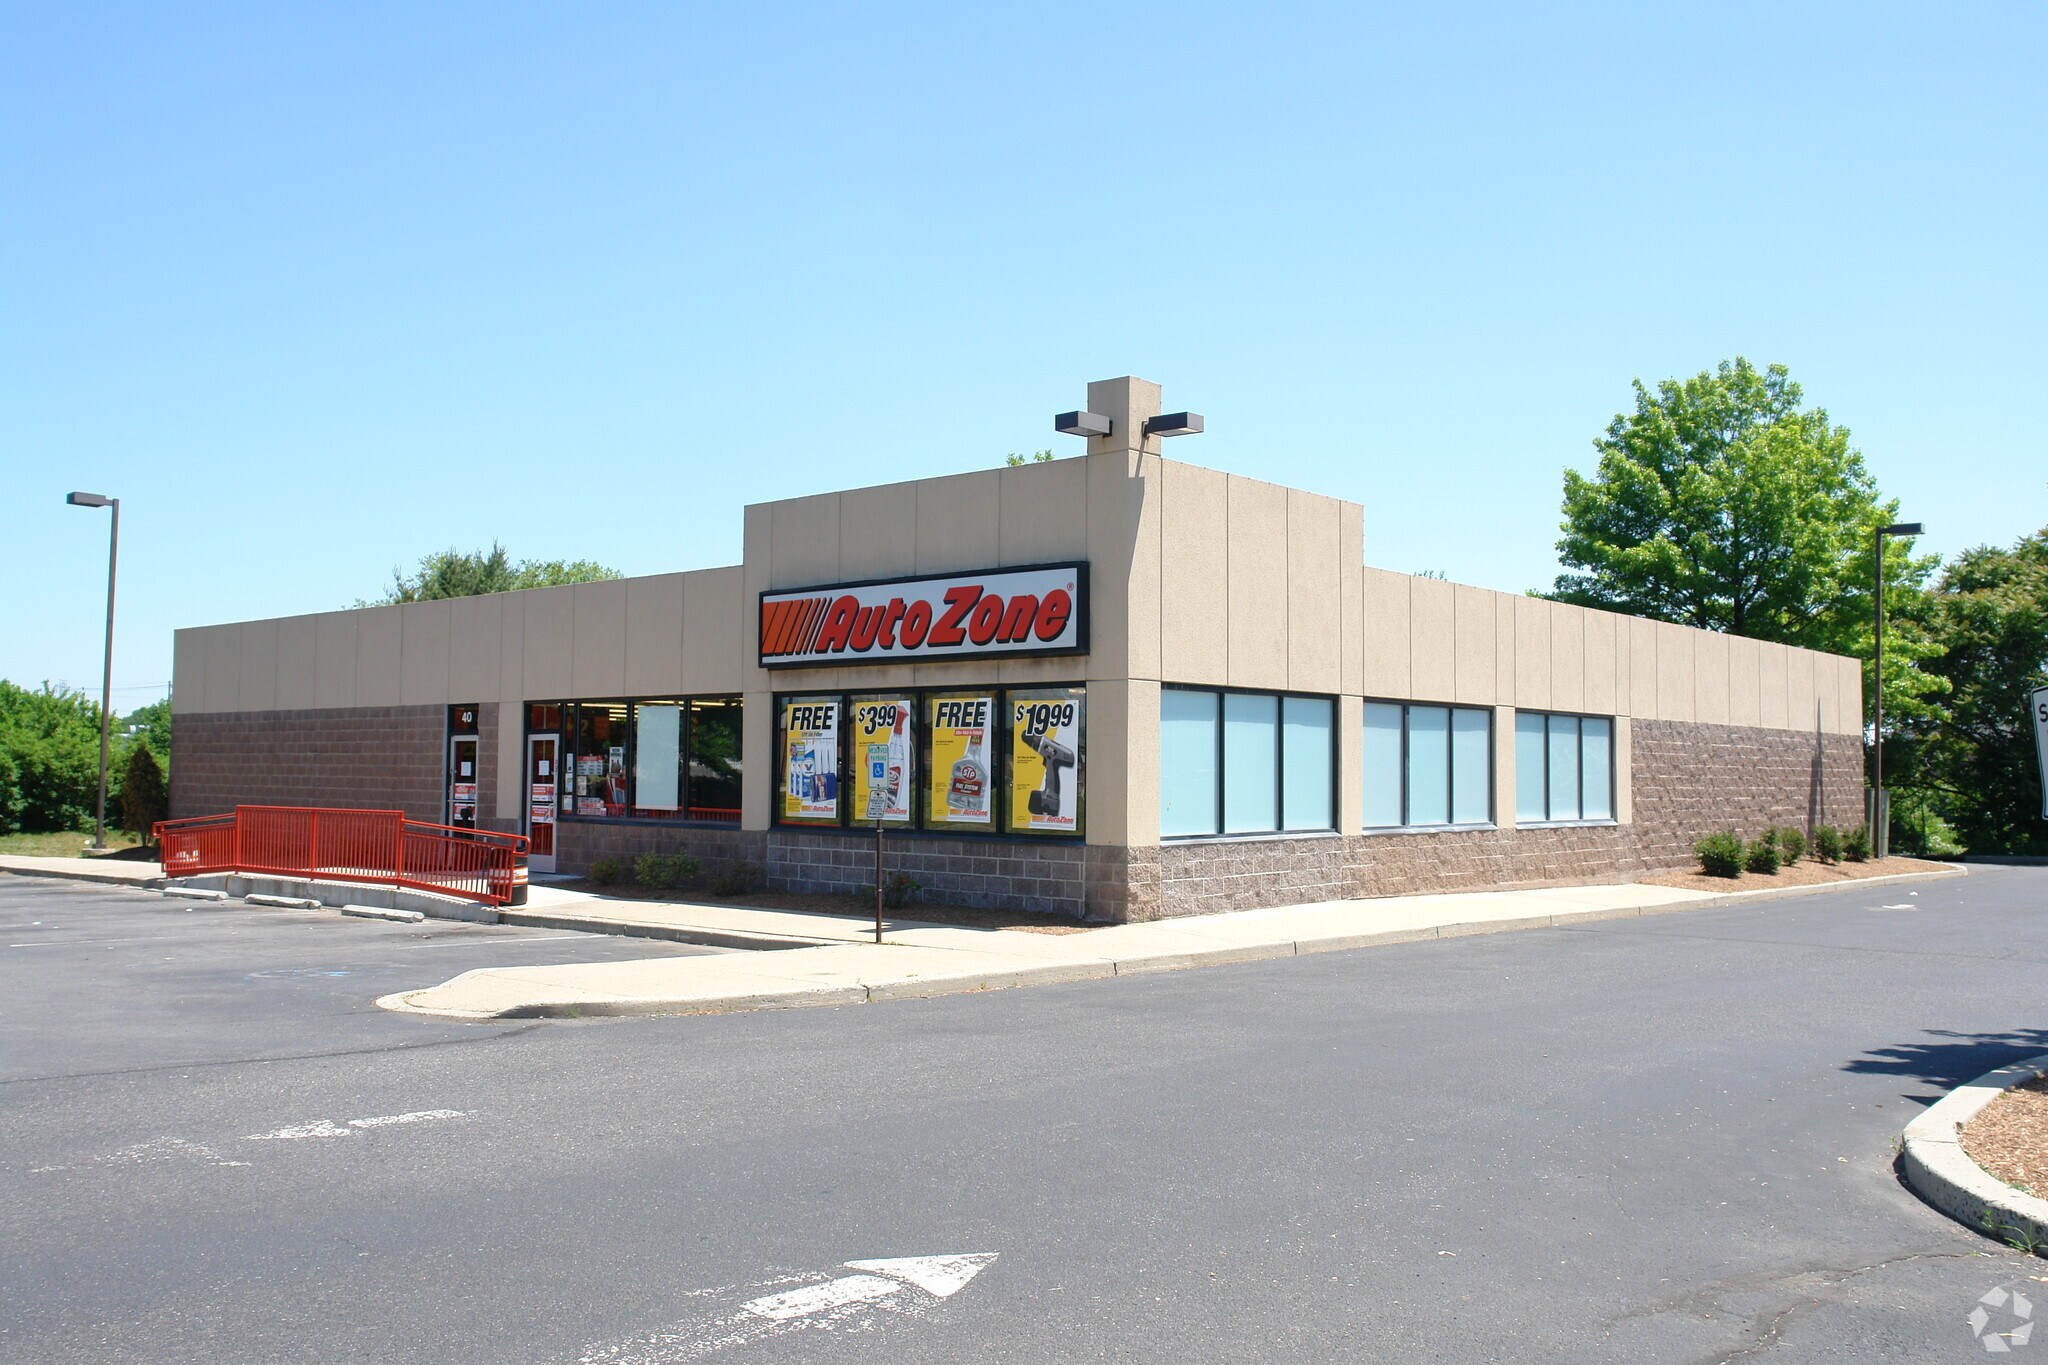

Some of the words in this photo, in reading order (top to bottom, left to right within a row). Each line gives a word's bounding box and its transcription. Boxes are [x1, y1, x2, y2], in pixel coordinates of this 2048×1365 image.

[814, 585, 1072, 652] AutoZone
[461, 711, 472, 723] 40
[790, 706, 834, 730] FREE
[935, 701, 988, 728] FREE
[963, 767, 976, 778] STP
